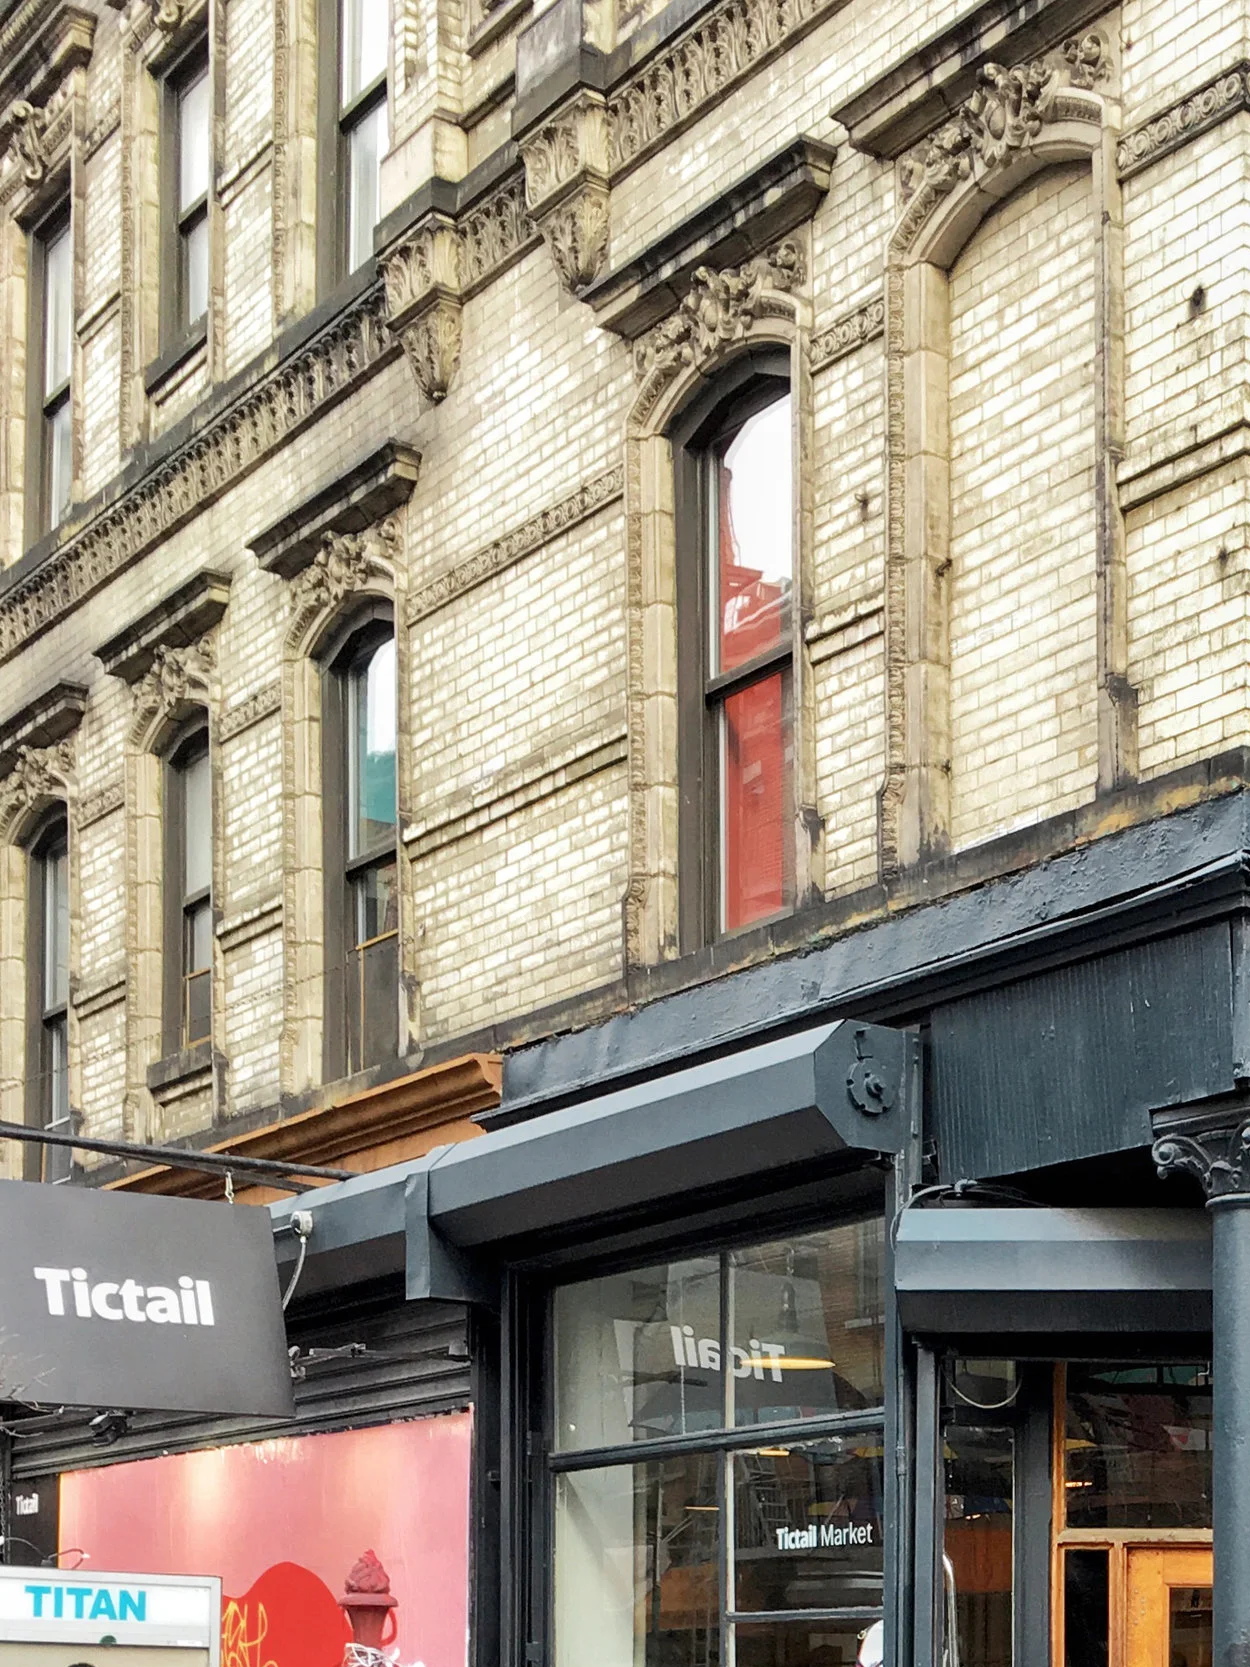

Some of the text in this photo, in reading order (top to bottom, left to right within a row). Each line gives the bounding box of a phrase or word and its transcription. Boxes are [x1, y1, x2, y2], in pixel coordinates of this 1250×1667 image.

[33, 1266, 215, 1327] Tictail
[775, 1521, 873, 1550] Tictail Market
[24, 1585, 147, 1622] TITAN
